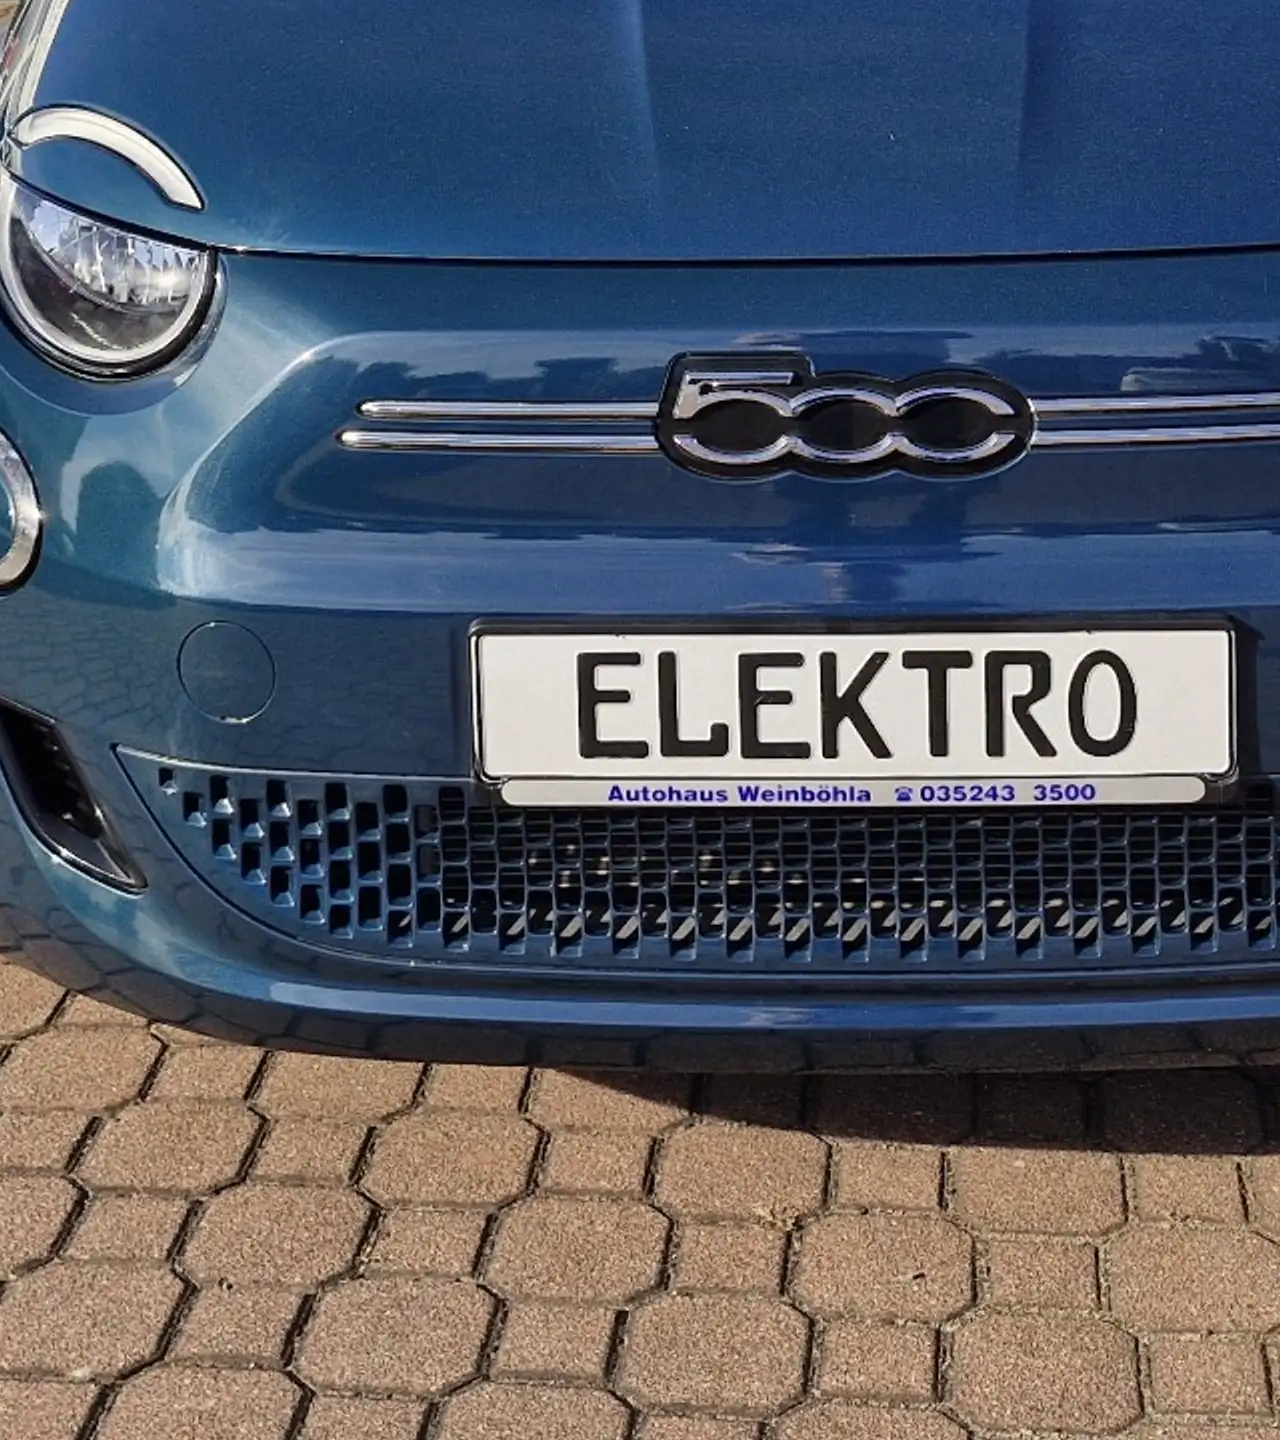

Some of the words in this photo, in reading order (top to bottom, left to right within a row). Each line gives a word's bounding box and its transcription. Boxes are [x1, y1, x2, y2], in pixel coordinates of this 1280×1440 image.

[670, 366, 1022, 470] 500
[576, 649, 1138, 760] ELEKTRO
[607, 784, 729, 804] Autohaus
[737, 783, 872, 804] Weinböhla
[919, 783, 1016, 804] 035243
[1032, 783, 1097, 803] 3500
